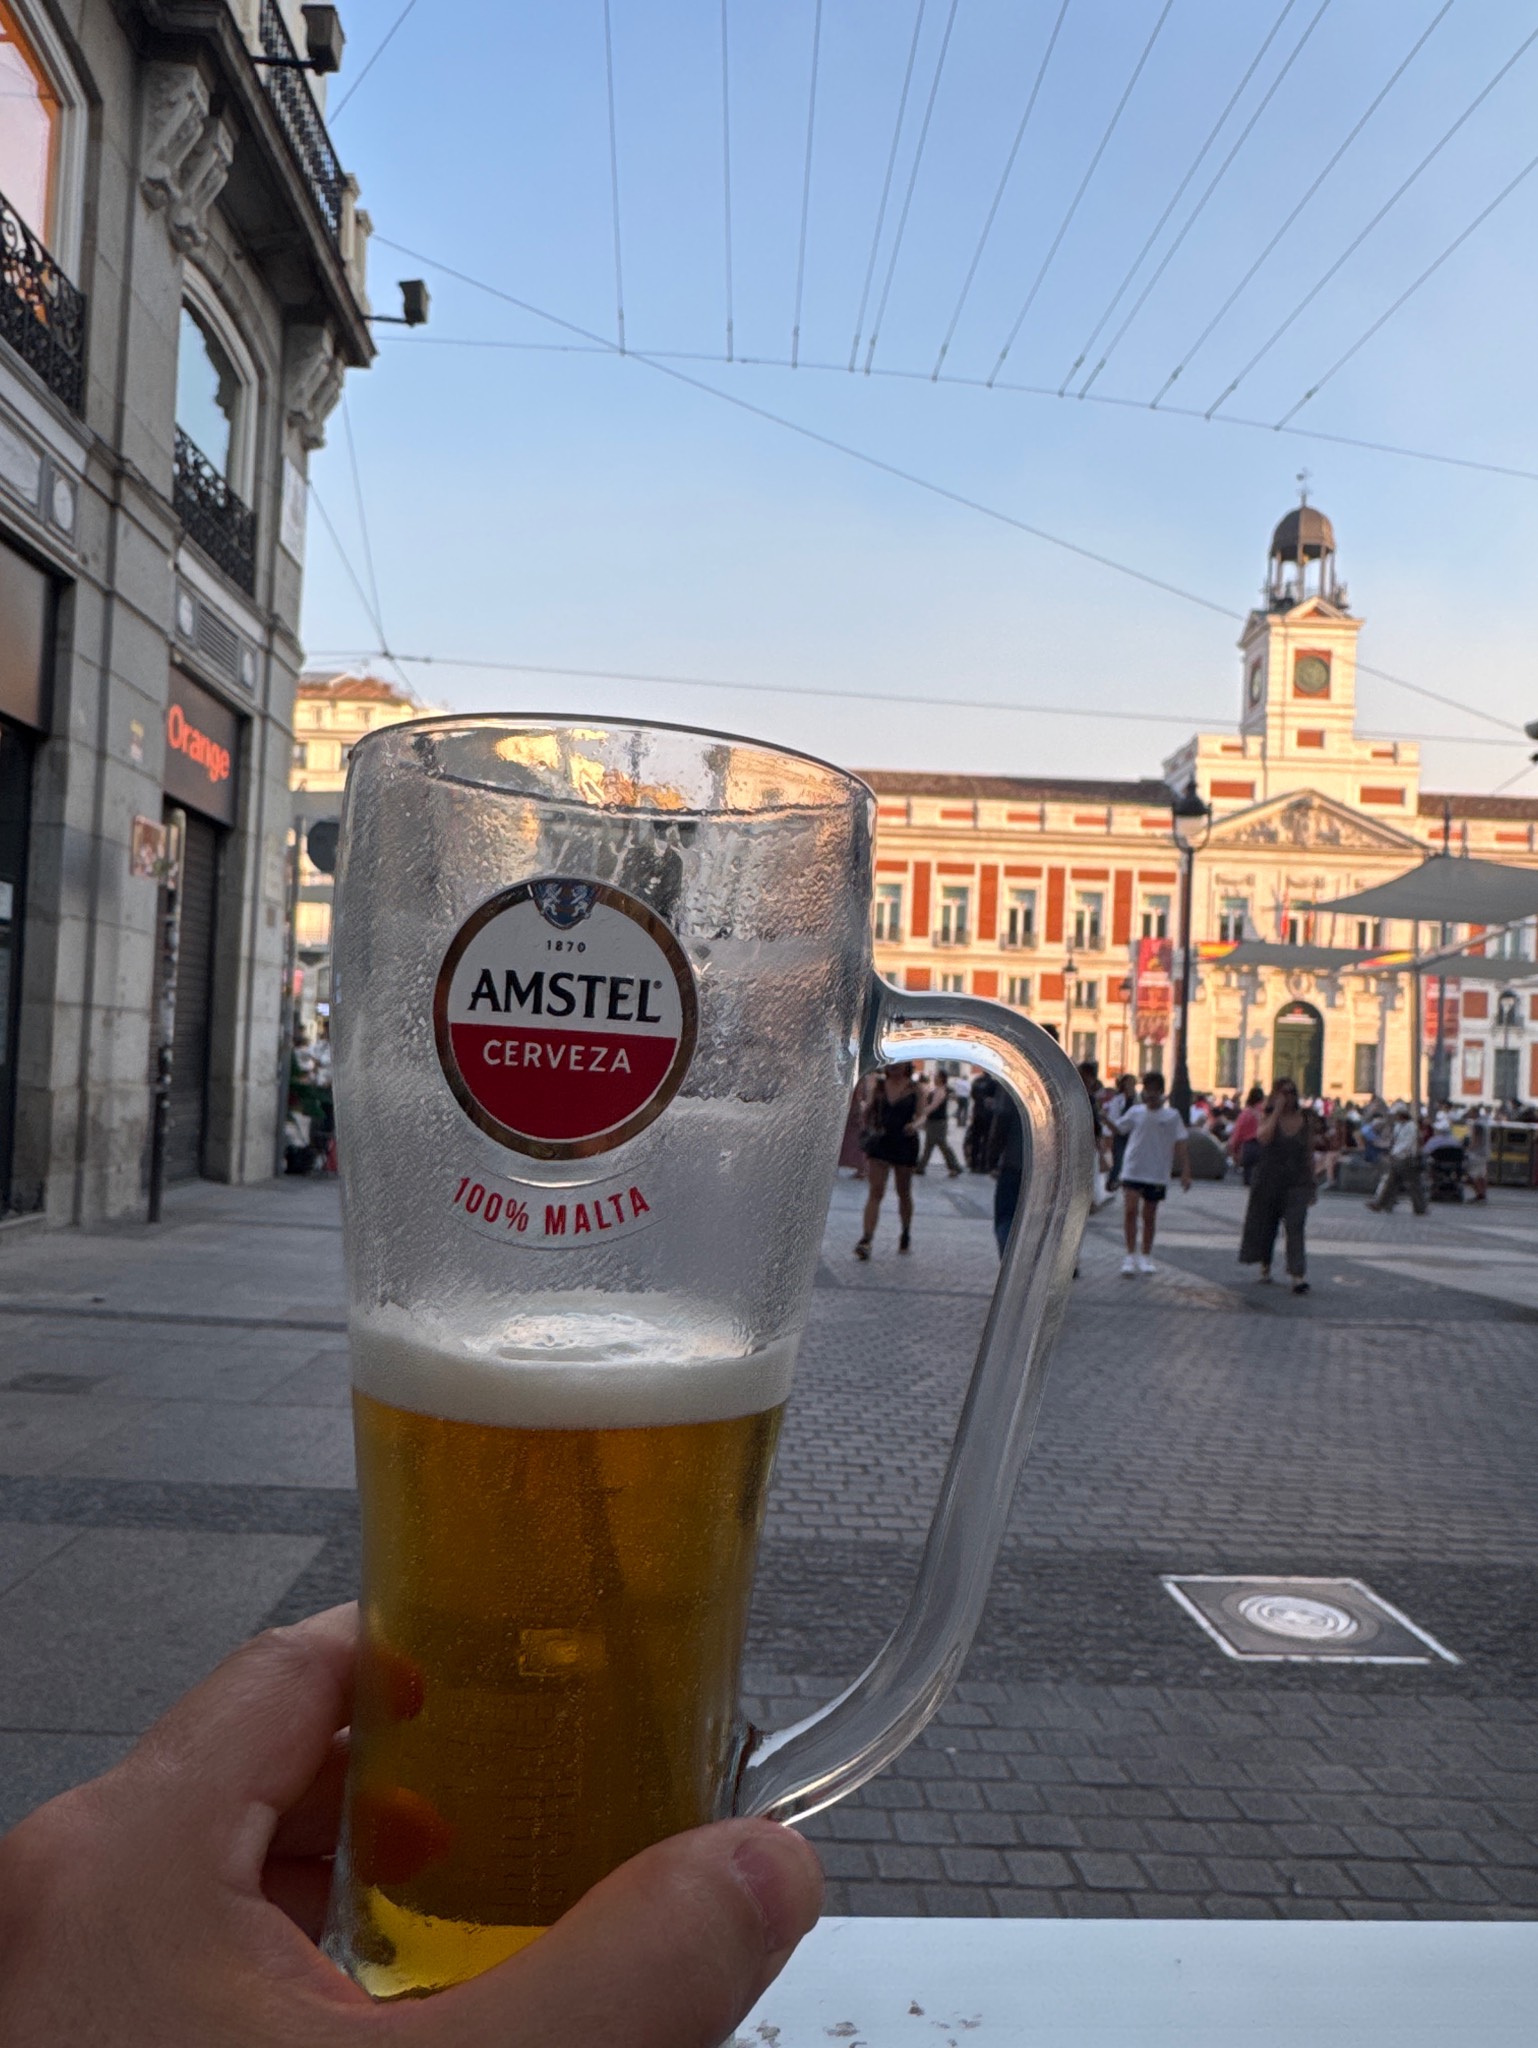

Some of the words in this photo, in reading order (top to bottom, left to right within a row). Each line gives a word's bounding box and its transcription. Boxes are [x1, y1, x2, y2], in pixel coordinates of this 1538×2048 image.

[168, 703, 231, 783] Orange
[546, 939, 587, 954] 1870
[482, 1039, 632, 1074] CERVEZA
[453, 1176, 530, 1233] 100%
[544, 1186, 651, 1236] MALTA
